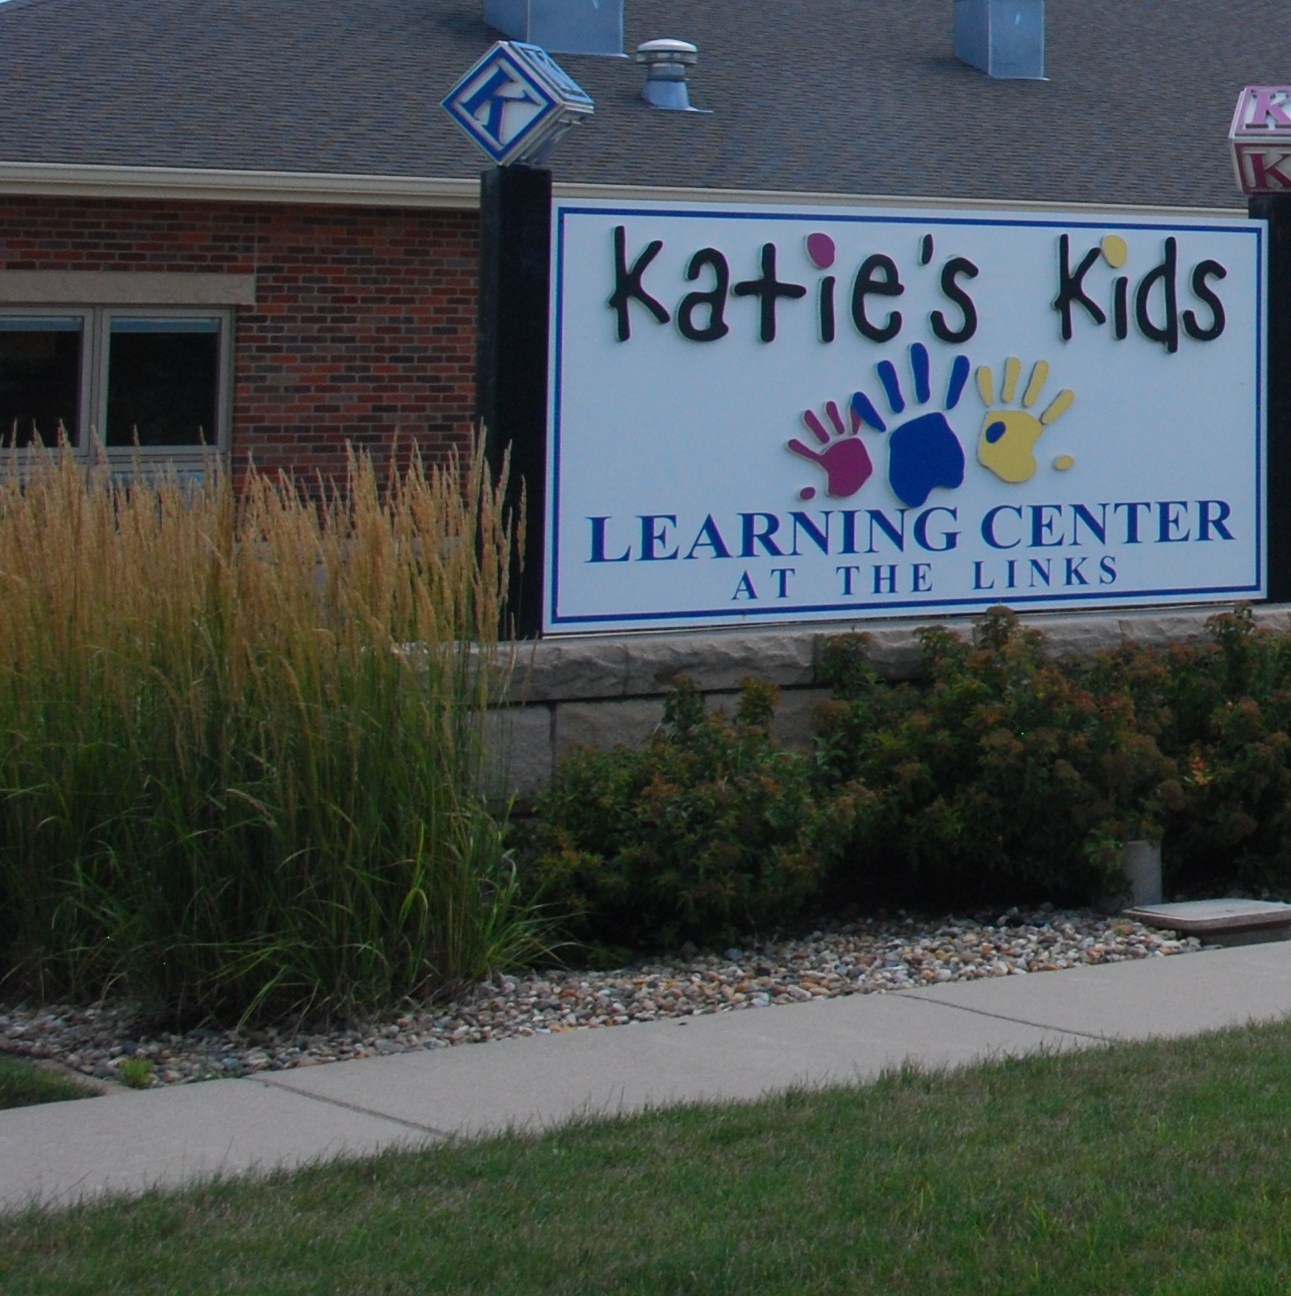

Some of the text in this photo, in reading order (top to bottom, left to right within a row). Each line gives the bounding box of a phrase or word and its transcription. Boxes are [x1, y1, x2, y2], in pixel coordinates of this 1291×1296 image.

[458, 62, 542, 147] K
[608, 224, 1228, 354] Katie's Kids
[584, 498, 1237, 565] LEARNING CENTER
[731, 555, 1119, 602] AT THE LINKS
